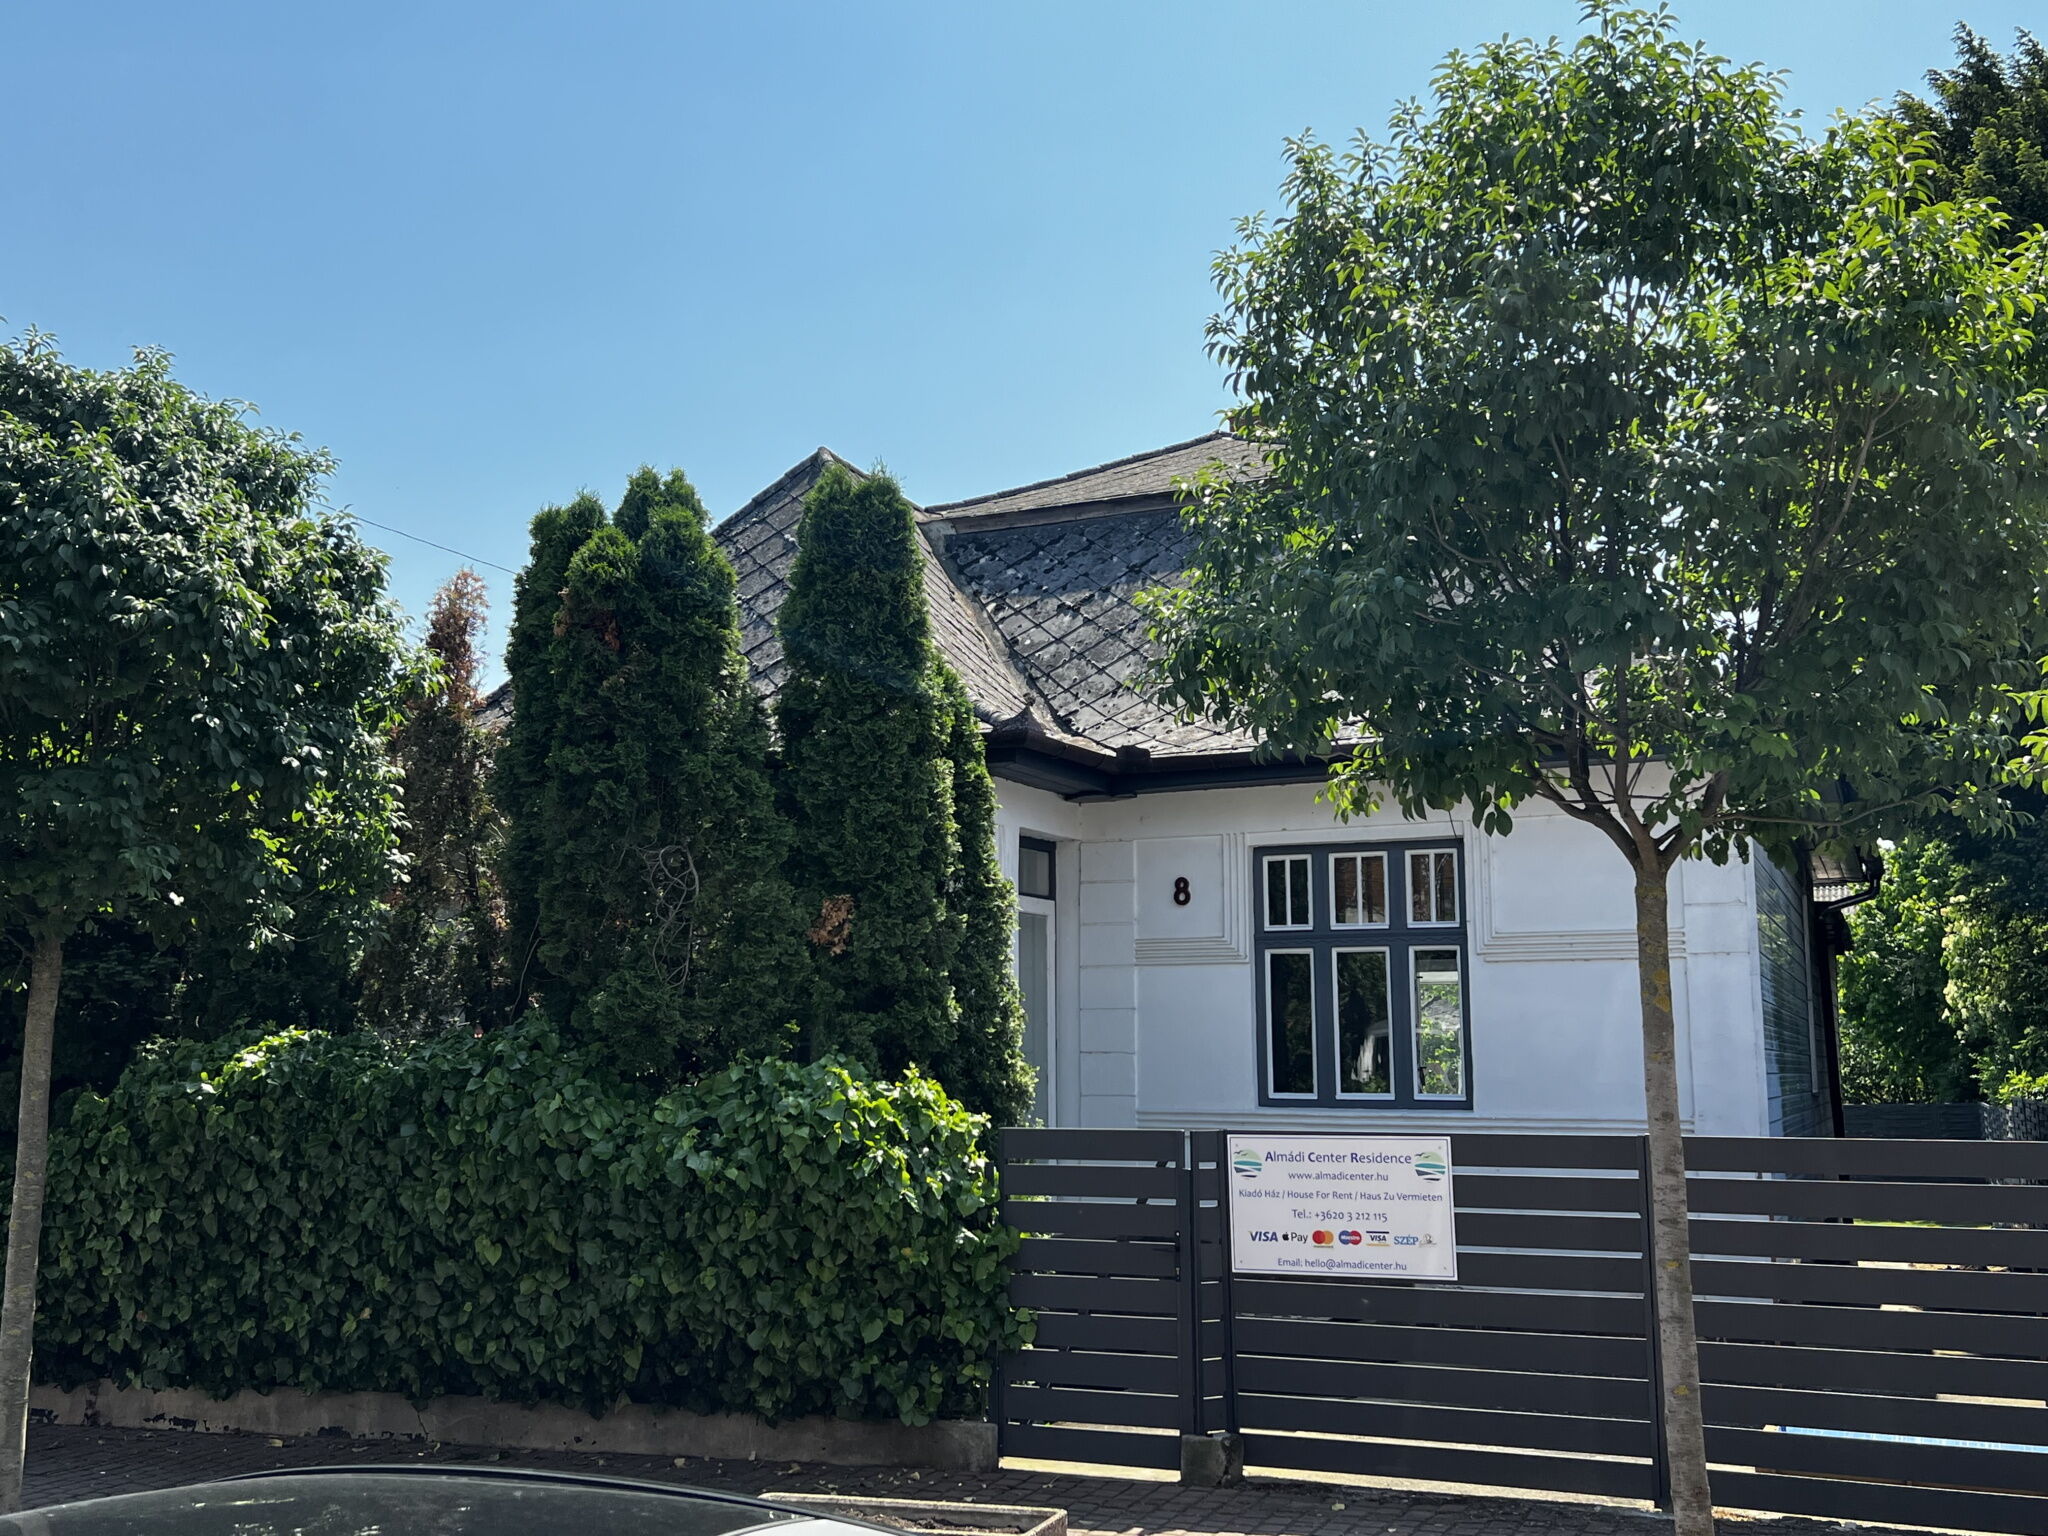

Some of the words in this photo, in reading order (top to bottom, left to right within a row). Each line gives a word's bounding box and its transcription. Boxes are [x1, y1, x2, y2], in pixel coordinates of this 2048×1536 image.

[1173, 877, 1191, 905] 8
[1265, 1151, 1305, 1162] Almádi
[1308, 1152, 1347, 1163] Center
[1350, 1152, 1412, 1164] Residence
[1288, 1171, 1389, 1181] www.almadicenter.hu
[1239, 1189, 1263, 1198] Kiadó
[1264, 1189, 1280, 1198] Ház
[1287, 1191, 1314, 1199] House
[1316, 1191, 1330, 1199] For
[1332, 1191, 1353, 1200] Rent
[1360, 1192, 1381, 1201] Haus
[1383, 1192, 1395, 1201] Zu
[1396, 1192, 1443, 1202] Vermieten
[1292, 1209, 1312, 1219] Tel.:
[1314, 1211, 1345, 1221] +3620
[1347, 1212, 1353, 1222] 3
[1355, 1212, 1370, 1221] 212
[1374, 1213, 1388, 1223] 115
[1249, 1231, 1278, 1242] VISA
[1290, 1232, 1308, 1244] Pay
[1393, 1235, 1419, 1246] SZÉP
[1277, 1258, 1303, 1267] Email:
[1304, 1259, 1407, 1271] hello@almadicenter.hu
